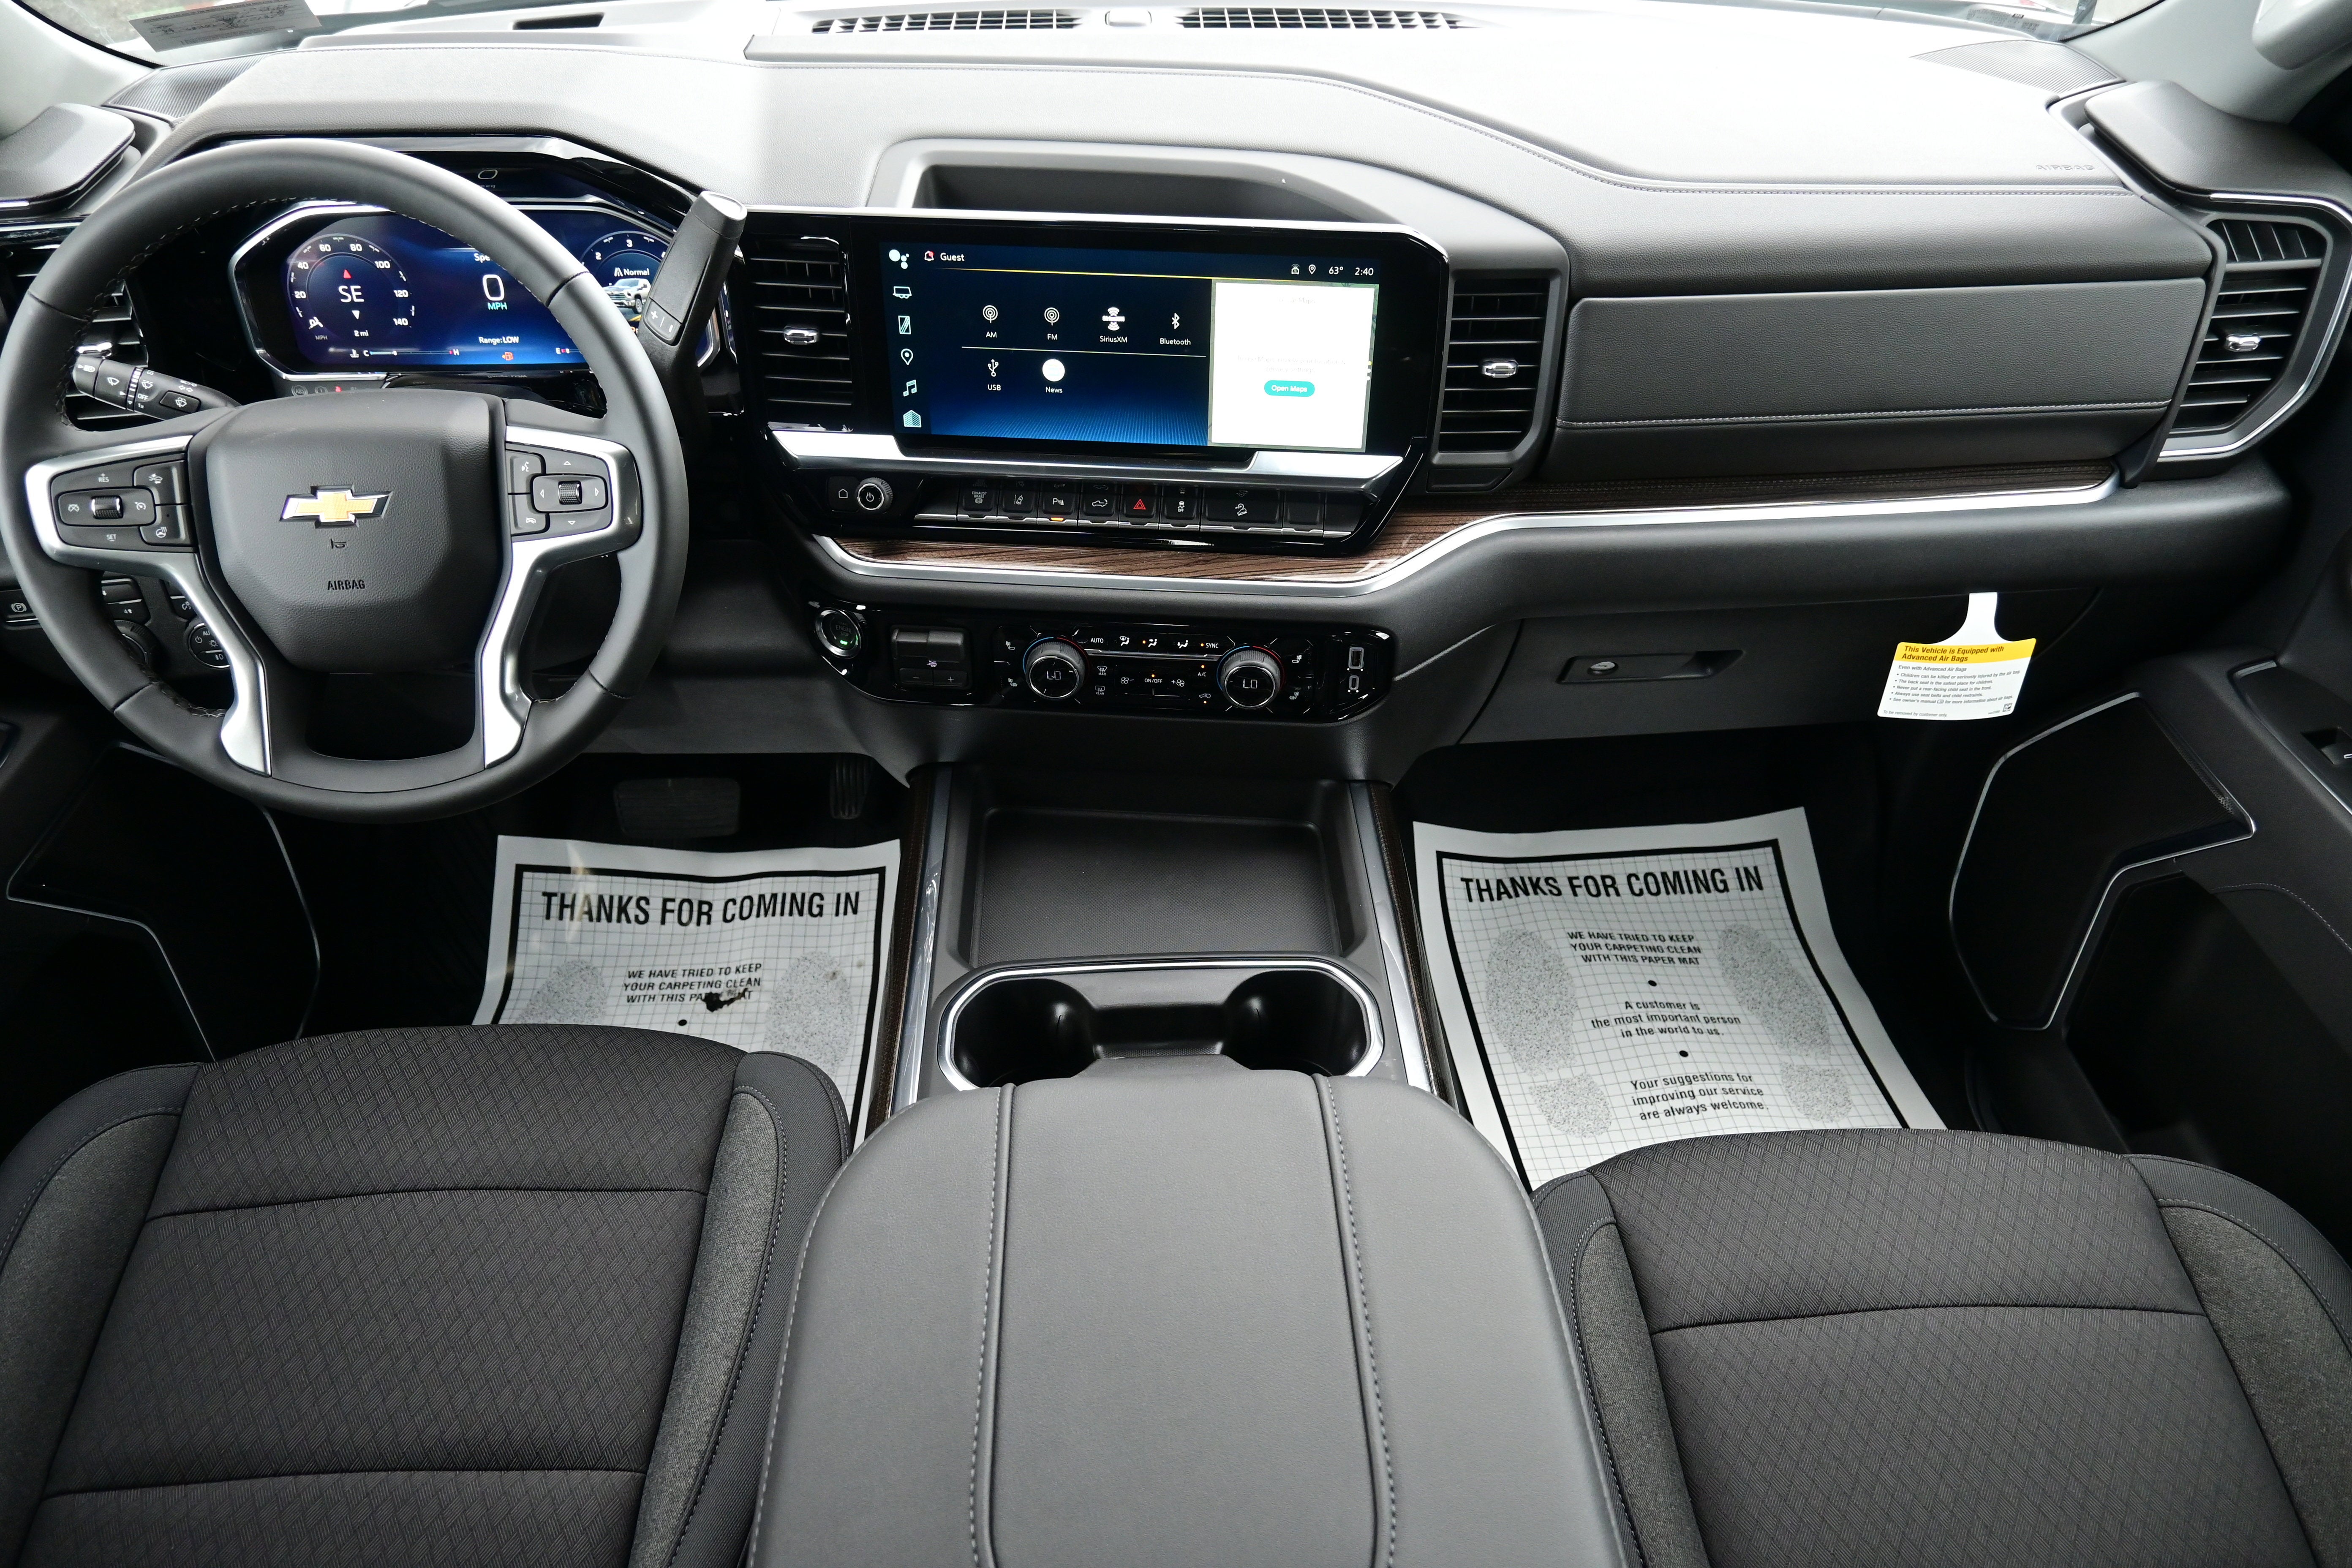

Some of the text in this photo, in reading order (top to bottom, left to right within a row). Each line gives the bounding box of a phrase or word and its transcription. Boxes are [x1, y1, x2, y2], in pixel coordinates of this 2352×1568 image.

[626, 239, 633, 248] 3
[474, 253, 490, 263] Spe
[940, 253, 964, 262] Guest
[375, 261, 390, 269] 100
[623, 268, 650, 276] Normal
[1328, 267, 1343, 275] 63°
[1355, 267, 1374, 275] 2:40
[483, 275, 504, 301] 0
[338, 286, 365, 302] SE
[487, 302, 507, 310] MPH
[1160, 338, 1191, 346] Bluetooth
[1290, 385, 1307, 393] Maps
[138, 393, 148, 401] OFF
[327, 580, 365, 591] AIRBAG
[1957, 647, 1988, 655] Equipped
[1902, 653, 1937, 661] Advanced
[1047, 671, 1061, 680] LO
[1243, 679, 1258, 689] LO
[1461, 866, 1764, 903] THANKS FOR COMING IN
[542, 891, 860, 926] THANKS FOR COMING IN
[1567, 931, 1694, 943] WE HAVE TRIED TO KEEP
[1571, 943, 1701, 954] YOUR CARPETING CLEAN
[1582, 954, 1701, 965] WITH THIS PAPER MAT
[628, 963, 762, 979] WE HAVE TRIED TO KEEP
[624, 977, 761, 991] YOUR CARPETING CLEAN
[626, 994, 655, 1003] WITH
[660, 994, 686, 1002] THIS
[1625, 1001, 1701, 1011] A customer is
[1591, 1013, 1742, 1029] the most important person
[1620, 1026, 1724, 1038] in the world to us.
[1631, 1072, 1753, 1091] Your suggestions for
[1632, 1086, 1764, 1106] improving our service
[1640, 1100, 1769, 1120] are always welcome.
